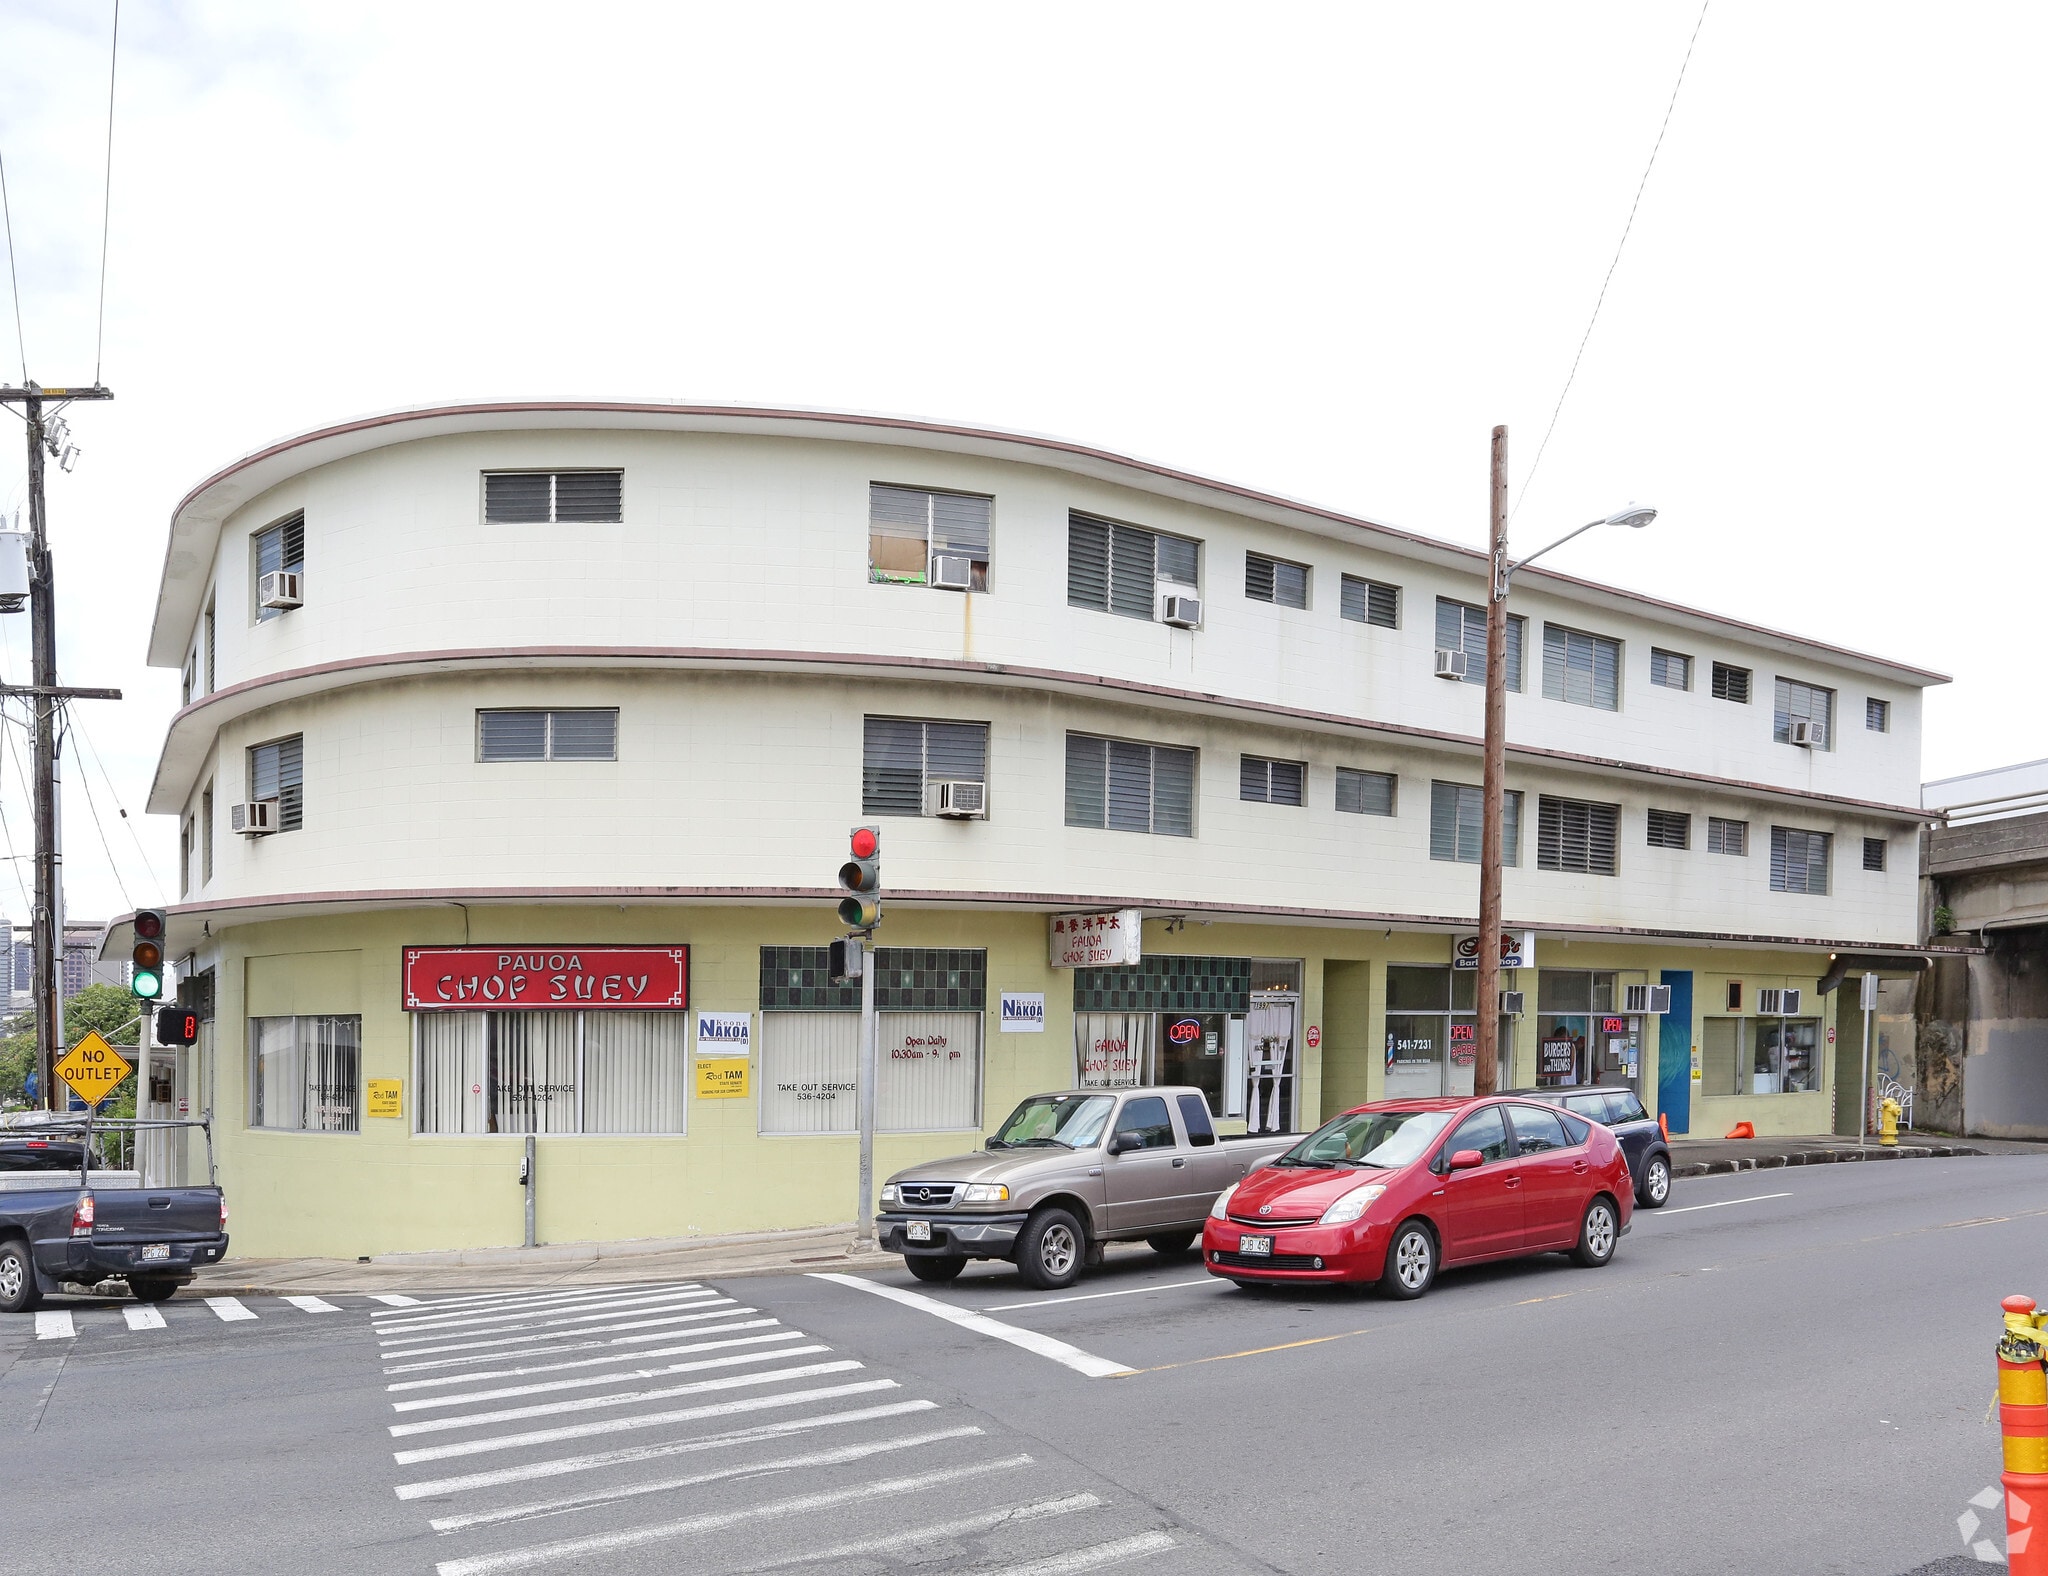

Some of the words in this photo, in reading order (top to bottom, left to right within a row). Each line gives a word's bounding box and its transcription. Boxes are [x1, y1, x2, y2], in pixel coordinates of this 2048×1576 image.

[1072, 935, 1101, 948] PAUOA
[1062, 950, 1084, 963] CHOP
[1088, 949, 1112, 961] SUEY
[1460, 959, 1479, 967] Bar
[1500, 958, 1518, 967] hop
[498, 955, 582, 971] PAUOA
[437, 974, 527, 1000] CHOP
[549, 974, 648, 1000] SUEY
[1003, 1000, 1043, 1017] NAKOA
[185, 1016, 195, 1038] 8
[700, 1019, 749, 1038] NAKOA
[716, 1019, 748, 1027] Keone
[1603, 1019, 1622, 1032] OPEN
[1171, 1025, 1200, 1039] OPEN
[1451, 1026, 1474, 1040] OPEN
[906, 1036, 925, 1048] Open
[928, 1035, 947, 1048] Daily
[1095, 1039, 1129, 1052] PAUOA
[1397, 1039, 1432, 1050] 541-7231
[82, 1050, 105, 1062] NO
[949, 1050, 961, 1060] pm
[1451, 1043, 1477, 1059] BARBE
[1543, 1042, 1571, 1058] BURGERS
[1083, 1059, 1108, 1072] CHOP
[1113, 1059, 1137, 1072] SUEY
[1550, 1058, 1571, 1072] THINGS
[64, 1067, 121, 1080] OUTLET
[705, 1072, 722, 1080] Rod
[724, 1070, 743, 1079] TAM
[496, 1085, 512, 1093] AKE
[538, 1084, 575, 1093] SERVICE
[777, 1083, 798, 1091] TAKE
[801, 1083, 818, 1091] OUT
[821, 1083, 856, 1091] SERVICE
[1085, 1079, 1098, 1087] TAKE
[1100, 1079, 1111, 1087] OUT
[1114, 1078, 1137, 1086] SERVICE
[385, 1090, 398, 1099] TAM
